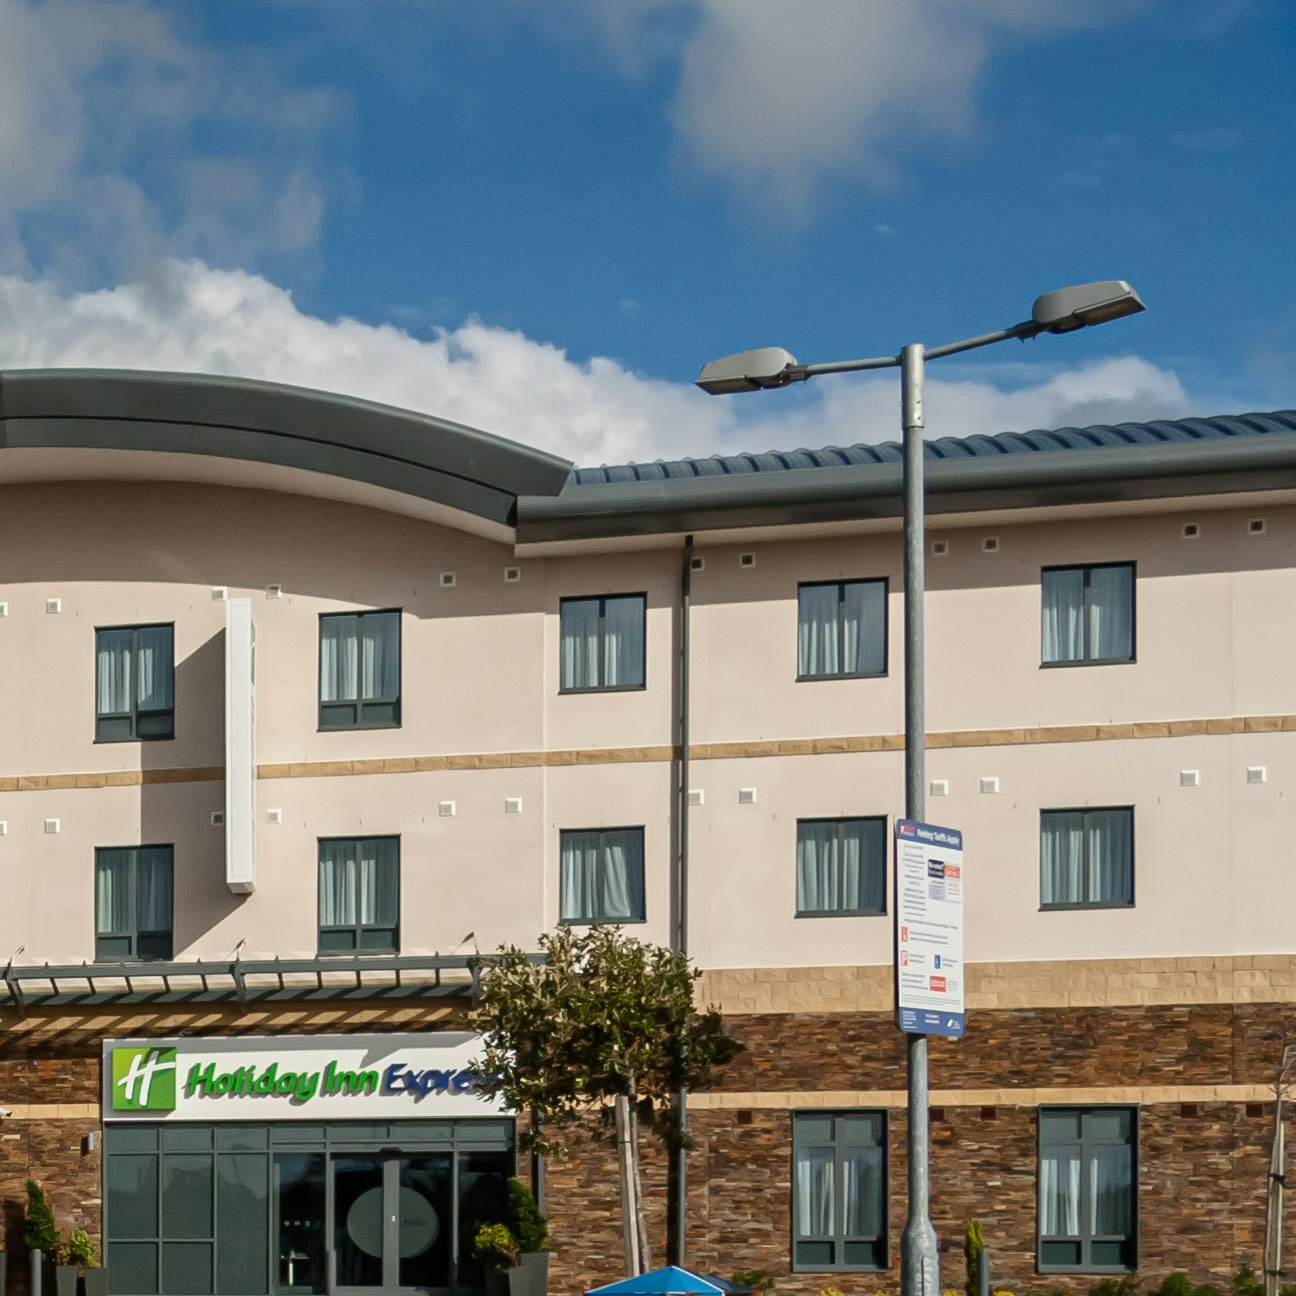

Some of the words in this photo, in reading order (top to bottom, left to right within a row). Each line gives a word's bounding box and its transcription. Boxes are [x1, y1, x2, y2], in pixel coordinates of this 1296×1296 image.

[189, 1061, 320, 1102] Holiday
[325, 1059, 379, 1093] Inn
[387, 1063, 502, 1096] Expre
